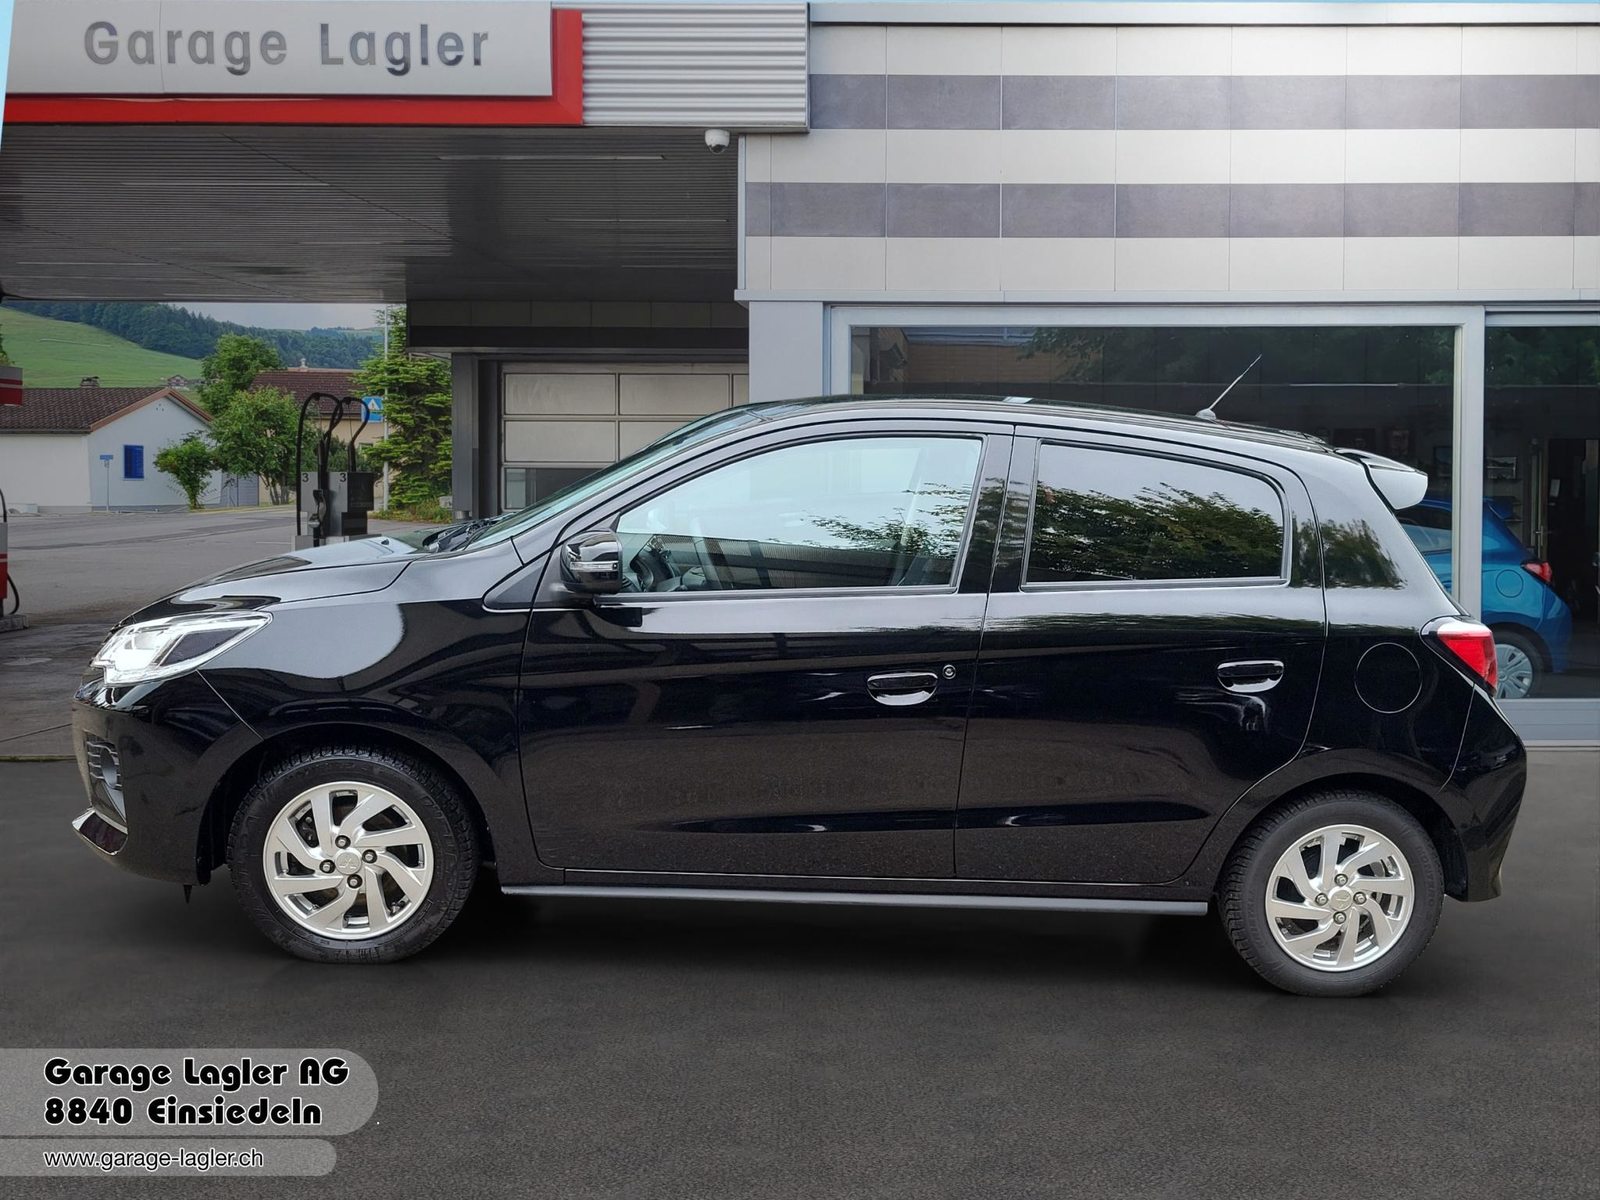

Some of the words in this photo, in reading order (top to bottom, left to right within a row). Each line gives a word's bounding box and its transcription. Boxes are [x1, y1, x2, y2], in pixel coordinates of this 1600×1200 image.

[84, 21, 287, 75] Garage
[319, 23, 489, 76] Lagler
[302, 472, 309, 482] 3
[340, 472, 346, 482] 3
